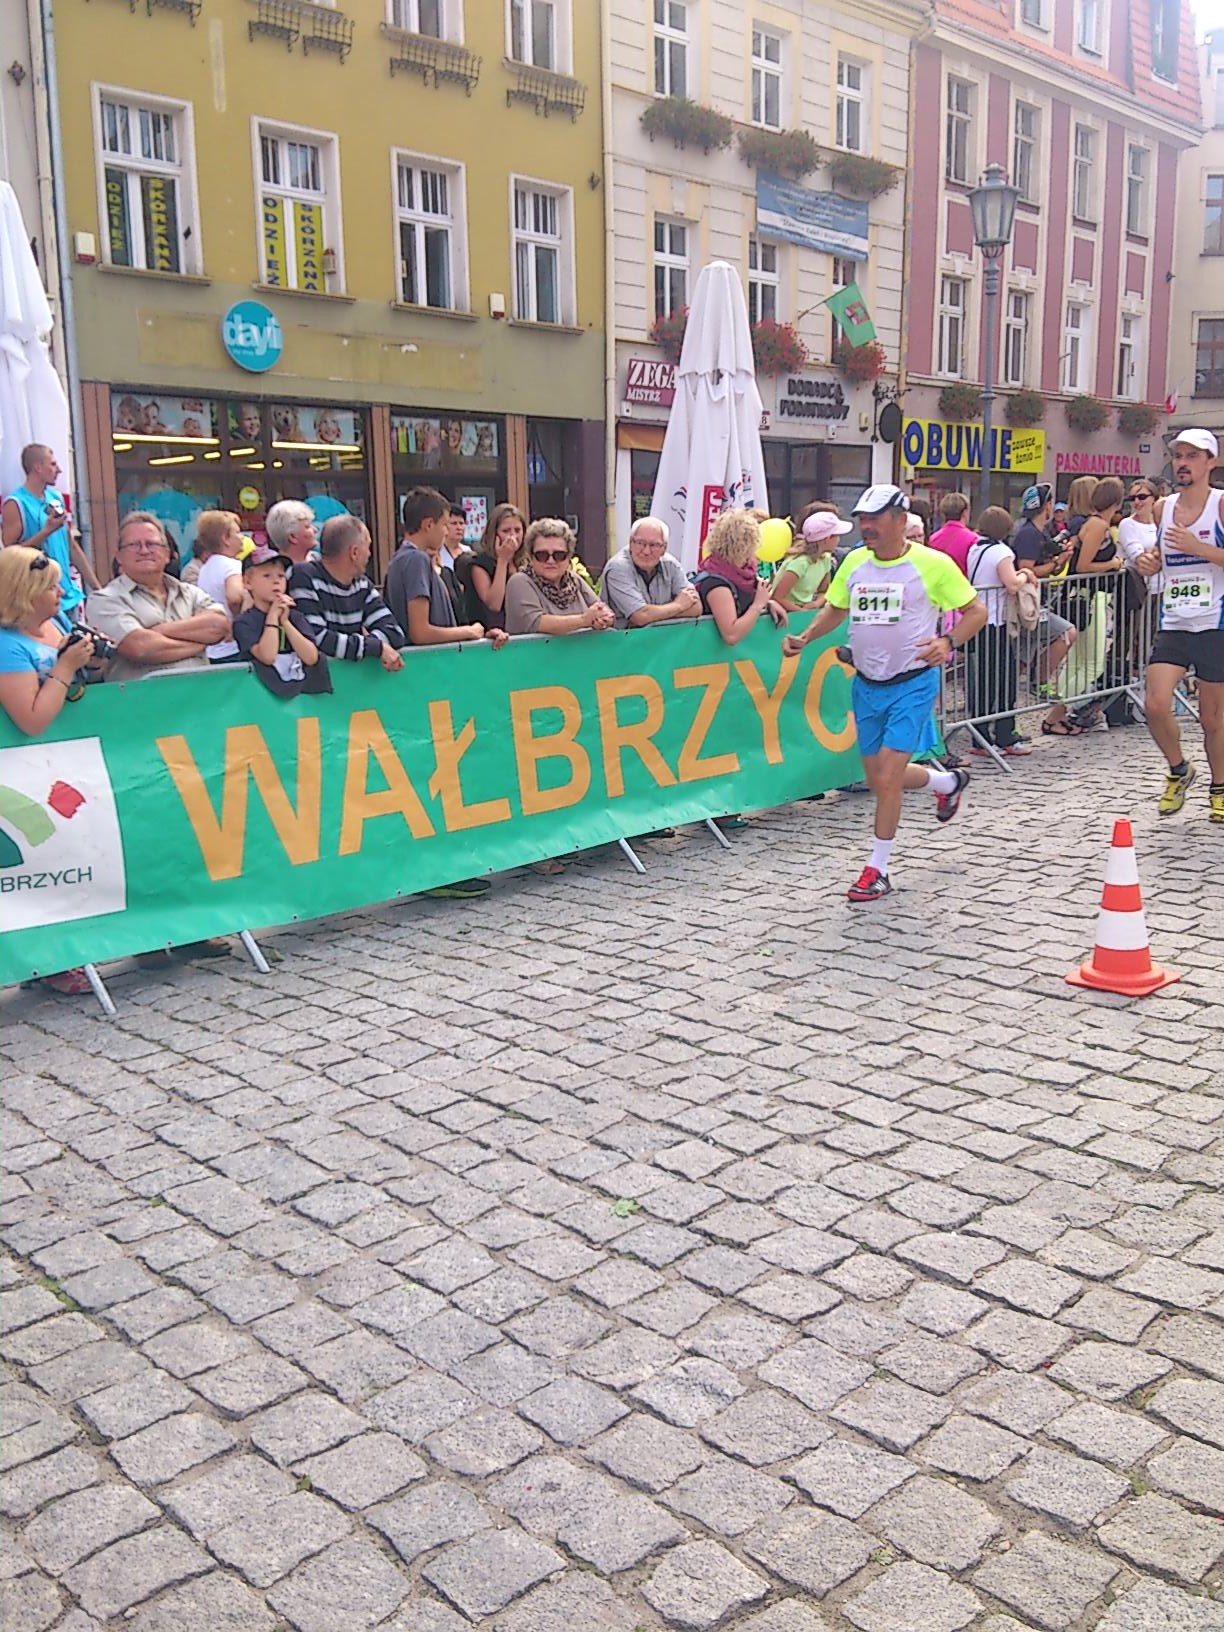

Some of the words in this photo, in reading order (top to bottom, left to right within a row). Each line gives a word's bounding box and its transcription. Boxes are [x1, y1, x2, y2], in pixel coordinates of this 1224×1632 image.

[223, 312, 283, 357] dayli
[626, 387, 661, 403] MISTRZ
[903, 420, 1012, 470] OBUWIE
[1056, 451, 1141, 475] PASMANTERIA
[858, 596, 889, 612] 811
[1170, 584, 1200, 600] 948
[0, 865, 92, 893] BRZYCH
